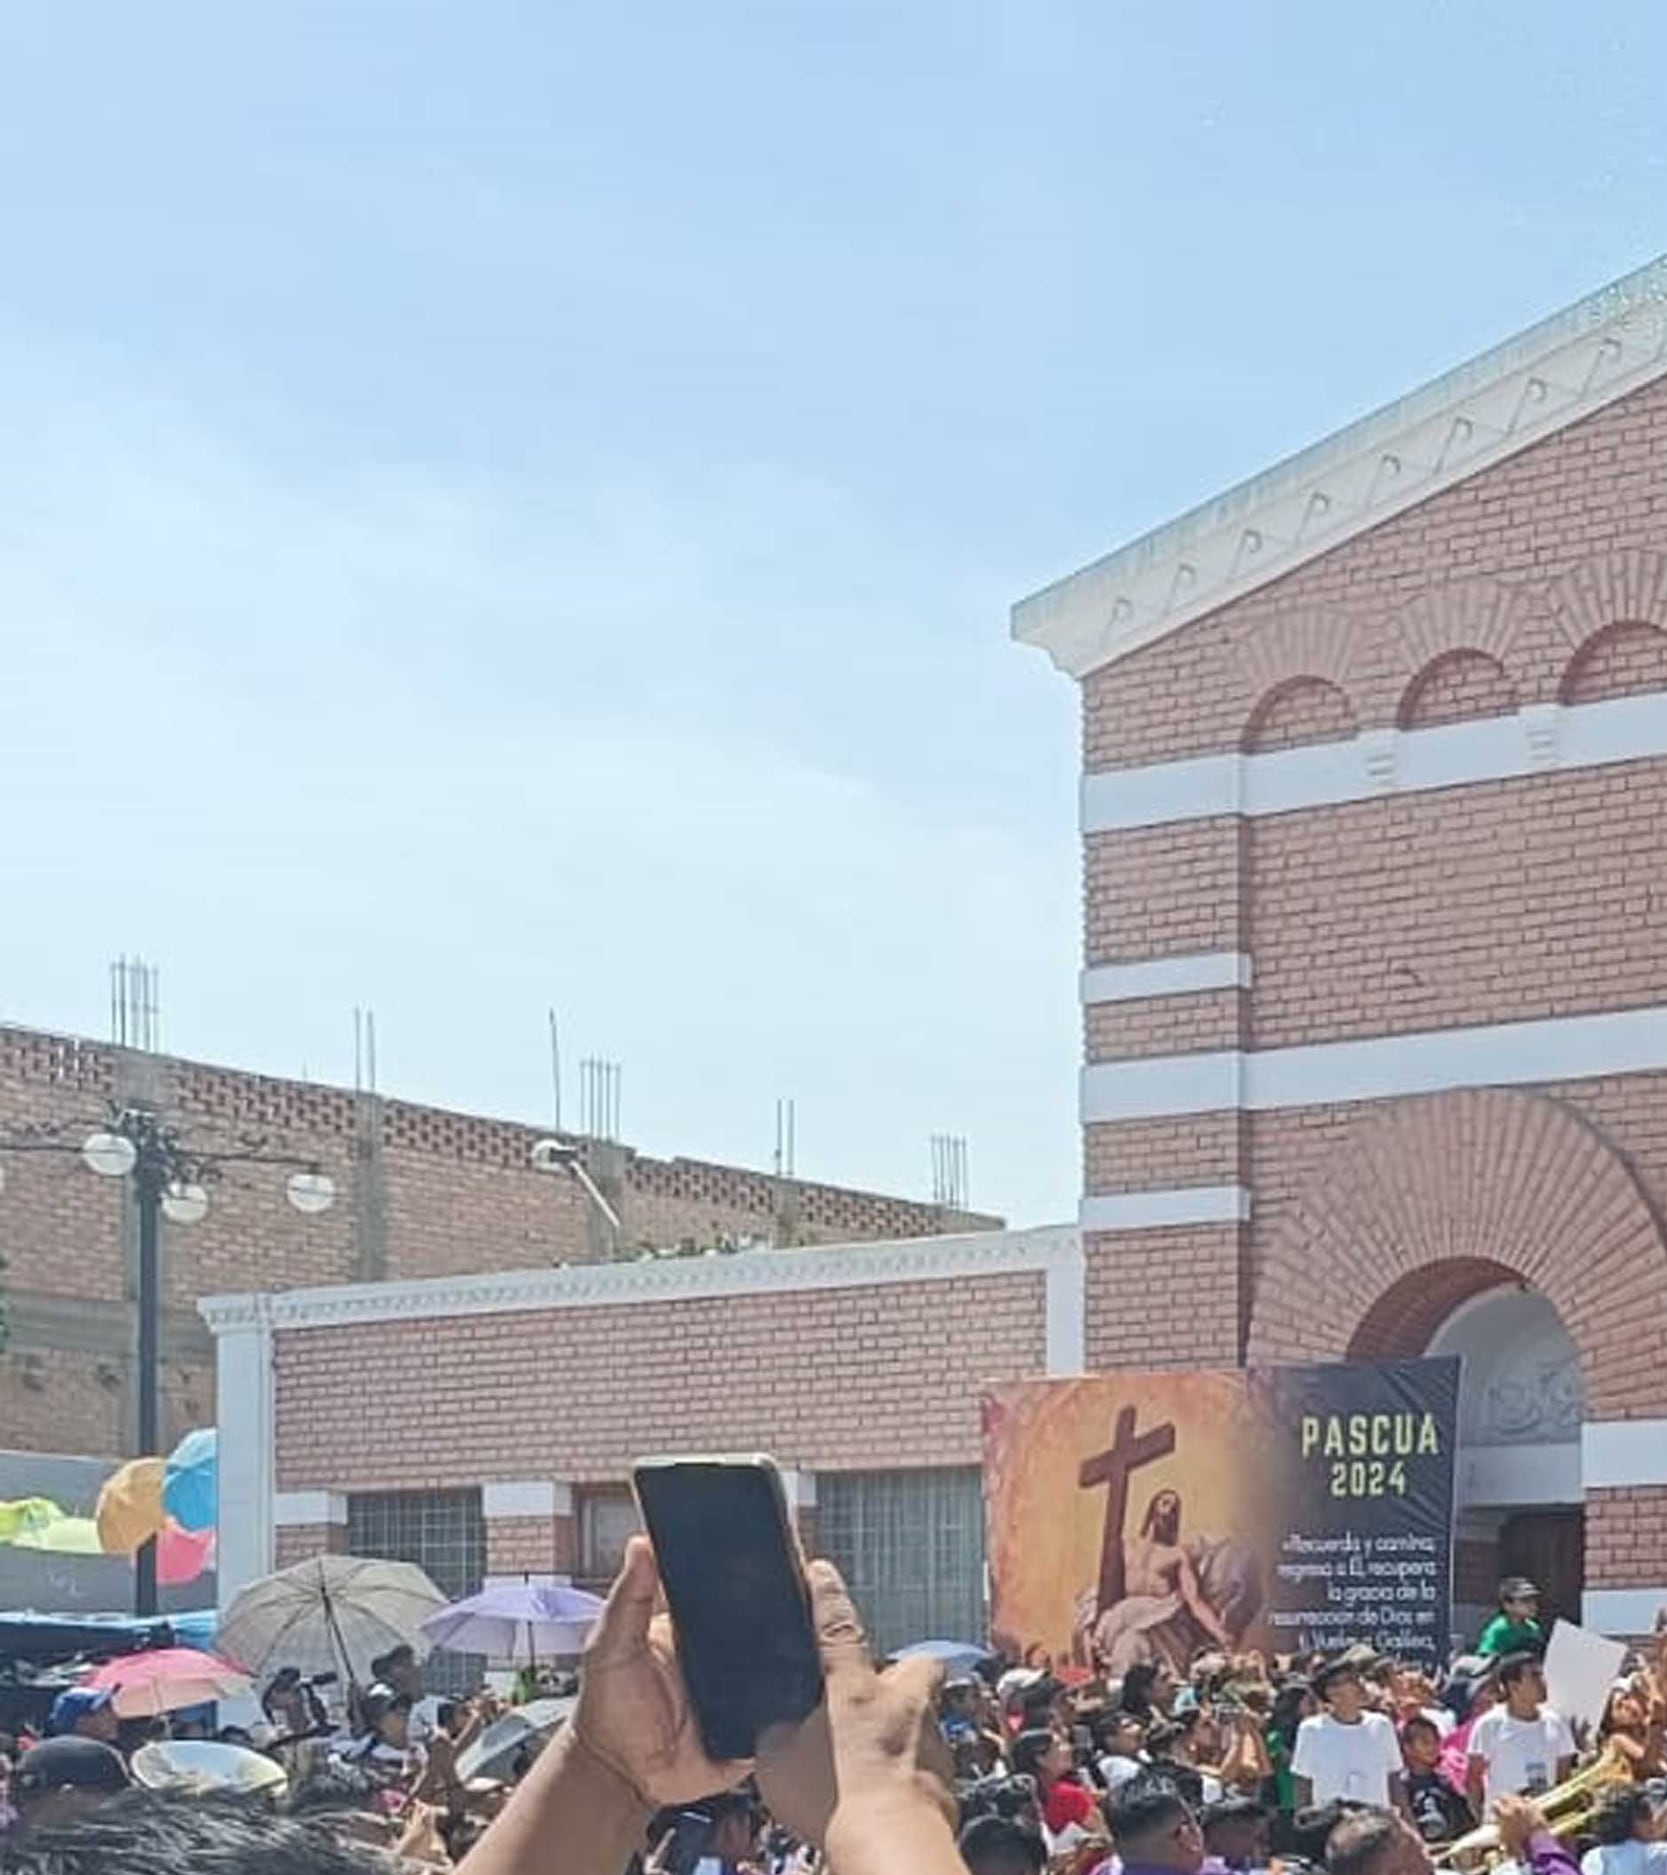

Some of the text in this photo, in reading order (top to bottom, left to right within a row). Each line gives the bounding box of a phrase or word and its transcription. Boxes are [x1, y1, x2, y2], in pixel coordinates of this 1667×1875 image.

[1301, 1411, 1439, 1459] PASCUA
[1330, 1460, 1406, 1497] 2024
[1363, 1538, 1372, 1557] y
[1368, 1561, 1437, 1581] recupera
[1327, 1579, 1436, 1606] la gracia de la
[1356, 1605, 1378, 1625] de
[1379, 1605, 1413, 1625] Dios
